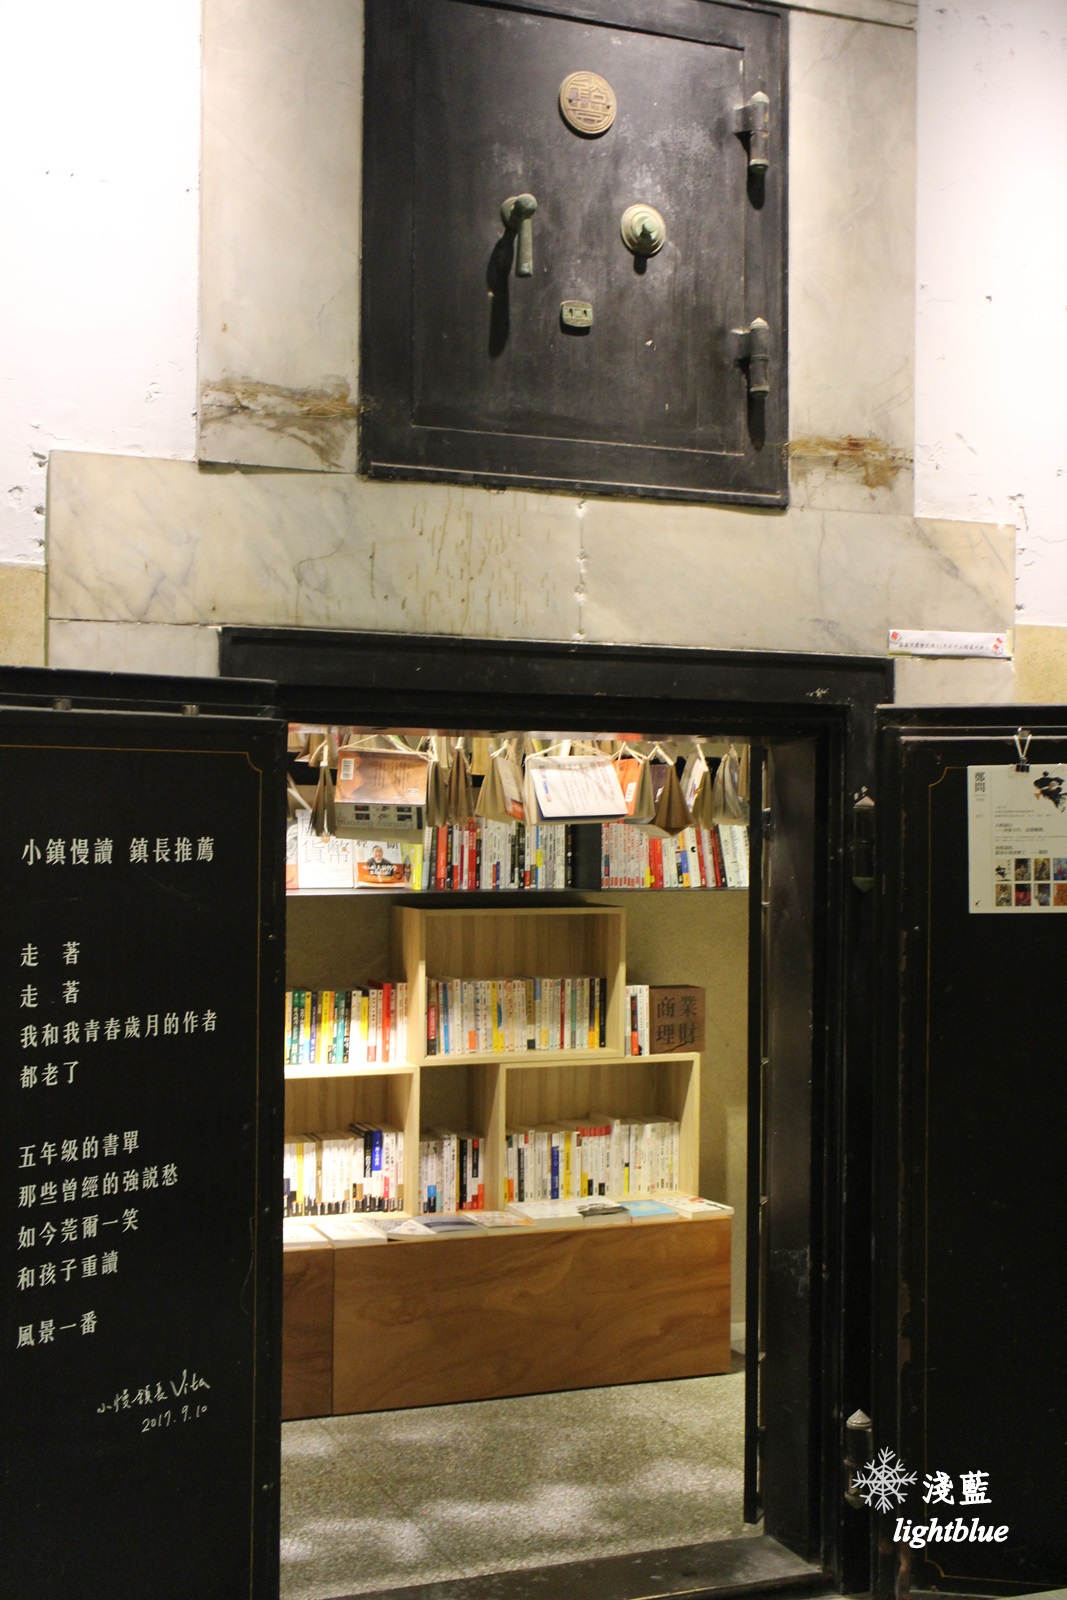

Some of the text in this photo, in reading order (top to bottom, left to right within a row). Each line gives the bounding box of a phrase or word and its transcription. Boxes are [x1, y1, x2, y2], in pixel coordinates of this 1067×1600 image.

[21, 837, 214, 866] 小鎮慢讀 鎮長推薦
[20, 1009, 217, 1049] 我和我青春歲月的作者
[19, 1060, 79, 1089] 都老了
[18, 1130, 139, 1169] 五年級的書單
[17, 1208, 139, 1250] 如今莞爾一笑
[17, 1250, 119, 1291] 和孩子重讀
[16, 1310, 98, 1349] 風景一番
[170, 1369, 211, 1397] Vita
